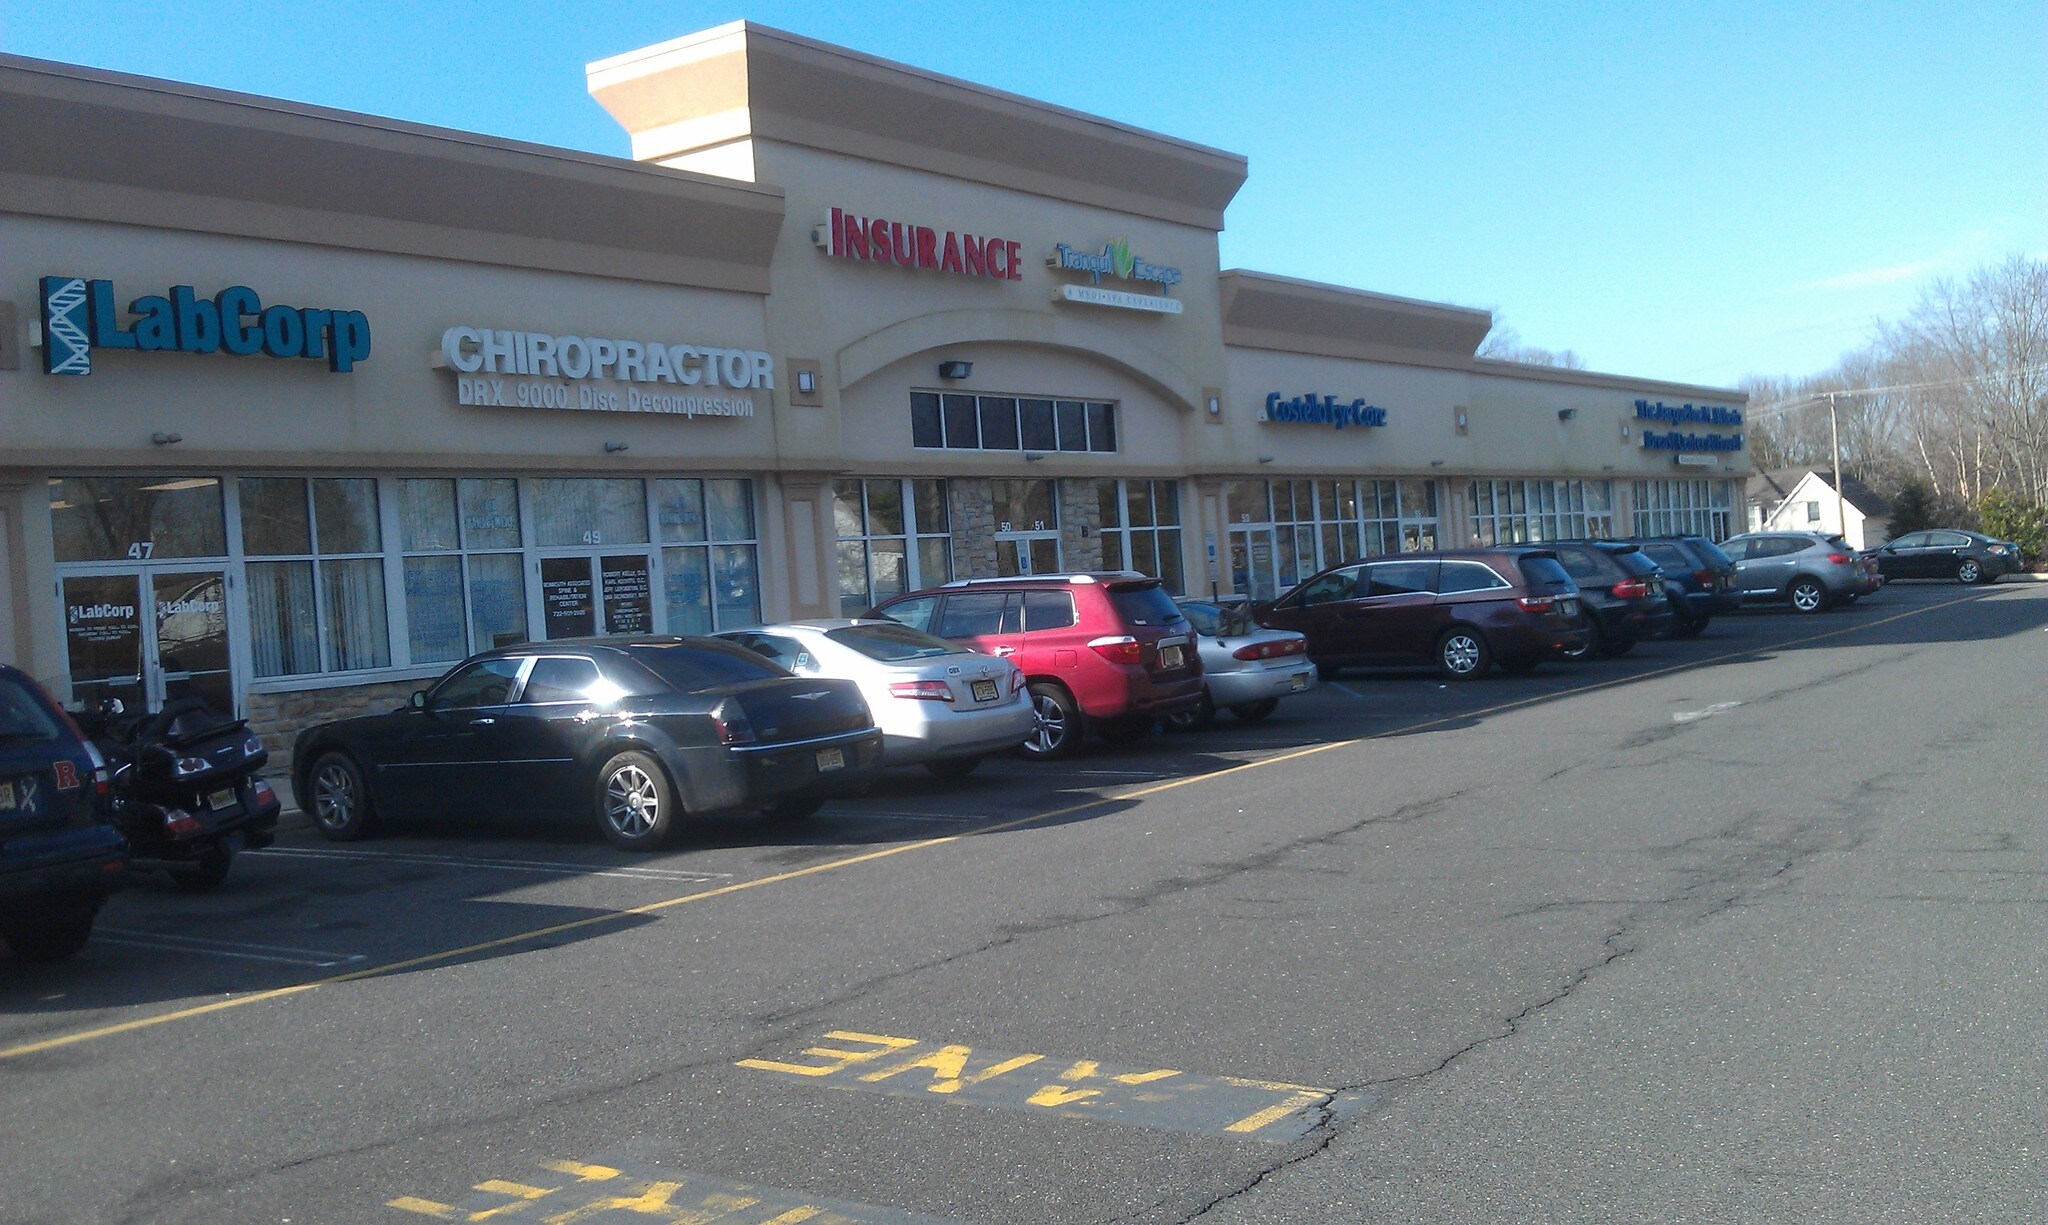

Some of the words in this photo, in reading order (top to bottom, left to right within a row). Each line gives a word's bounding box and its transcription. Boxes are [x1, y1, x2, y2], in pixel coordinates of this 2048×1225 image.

[827, 207, 1023, 281] INSURANCE
[1057, 243, 1114, 284] Tranquil
[1133, 255, 1182, 296] Escape
[87, 279, 371, 372] LabCorp
[441, 325, 774, 389] CHIROPRACTOR
[458, 377, 506, 406] DRX
[516, 382, 569, 409] 9000
[579, 384, 620, 412] Disc
[627, 387, 754, 419] Decompression
[1266, 391, 1327, 423] Costello
[1351, 398, 1387, 427] Care
[582, 530, 600, 545] 49
[1001, 522, 1012, 533] 50
[1034, 521, 1045, 531] 51
[128, 543, 153, 559] 47
[79, 603, 134, 619] LabCorp
[167, 600, 219, 615] LabCorp
[53, 760, 80, 790] R
